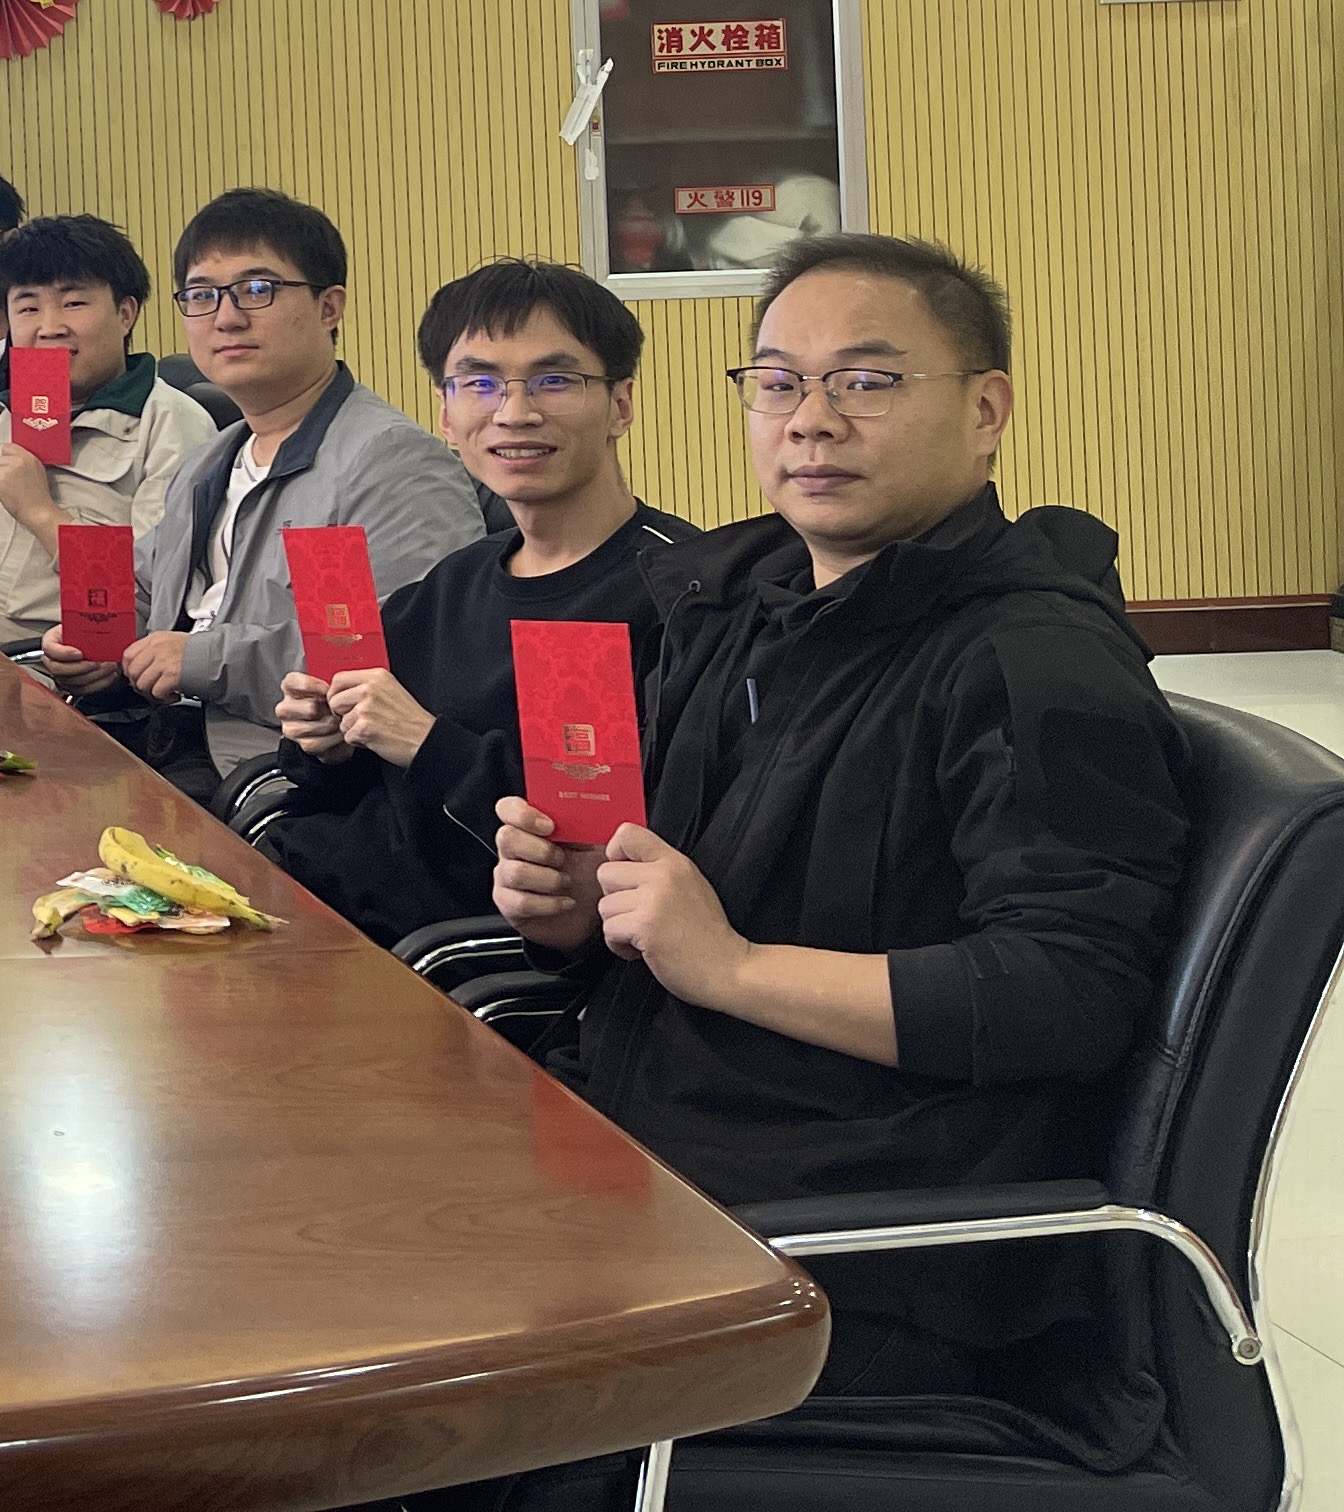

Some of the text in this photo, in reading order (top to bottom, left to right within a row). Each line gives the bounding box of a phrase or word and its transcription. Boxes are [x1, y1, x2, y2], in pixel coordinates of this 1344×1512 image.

[657, 23, 781, 54] 消火栓箱
[657, 57, 783, 71] FIRE HYDRANT BOX
